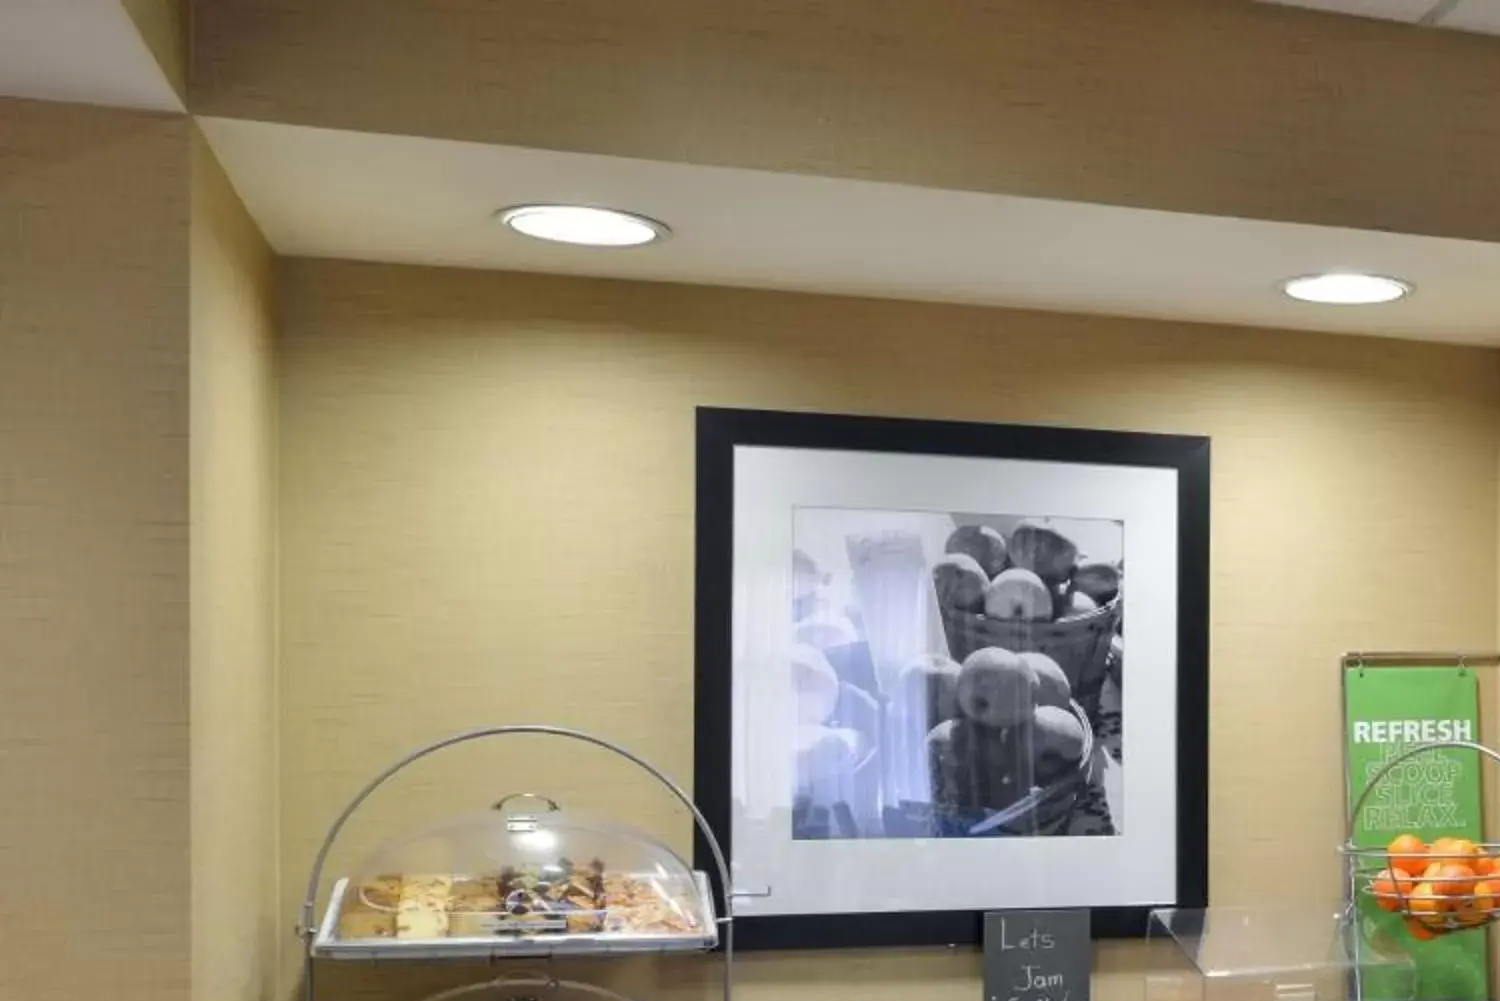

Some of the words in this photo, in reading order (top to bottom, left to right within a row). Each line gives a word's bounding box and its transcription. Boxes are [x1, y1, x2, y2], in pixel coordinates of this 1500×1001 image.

[1353, 719, 1472, 744] REFRESH
[1364, 761, 1463, 785] SCOOP
[1375, 783, 1454, 805] SLICE
[1363, 804, 1468, 831] RELAX.
[1000, 916, 1056, 951] Lets
[1013, 963, 1063, 991] Jam
